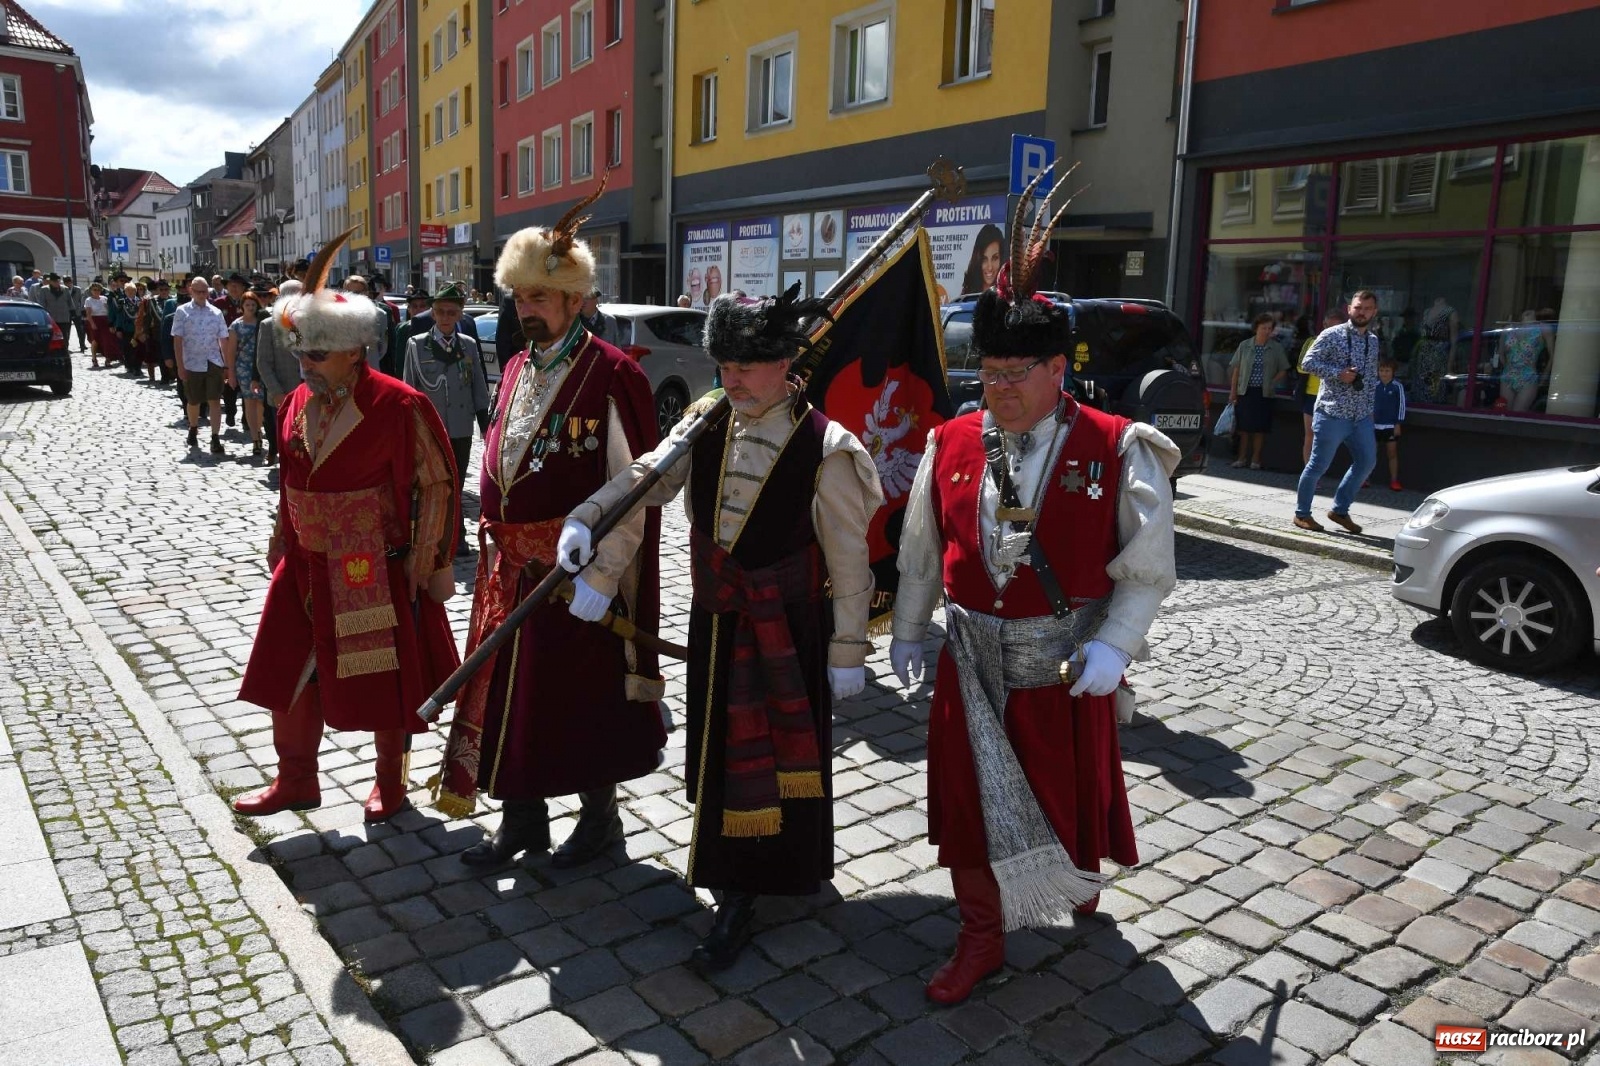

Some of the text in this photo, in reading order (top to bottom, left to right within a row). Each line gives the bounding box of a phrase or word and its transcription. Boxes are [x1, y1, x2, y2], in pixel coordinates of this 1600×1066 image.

[1021, 142, 1047, 188] P
[850, 211, 906, 229] STOMATOLOG
[935, 204, 991, 223] PROTETYKA
[687, 228, 725, 241] STOMATOLOGIA
[739, 223, 772, 237] PROTETYKA
[114, 237, 125, 251] P
[378, 247, 388, 261] P
[1129, 257, 1141, 269] 52
